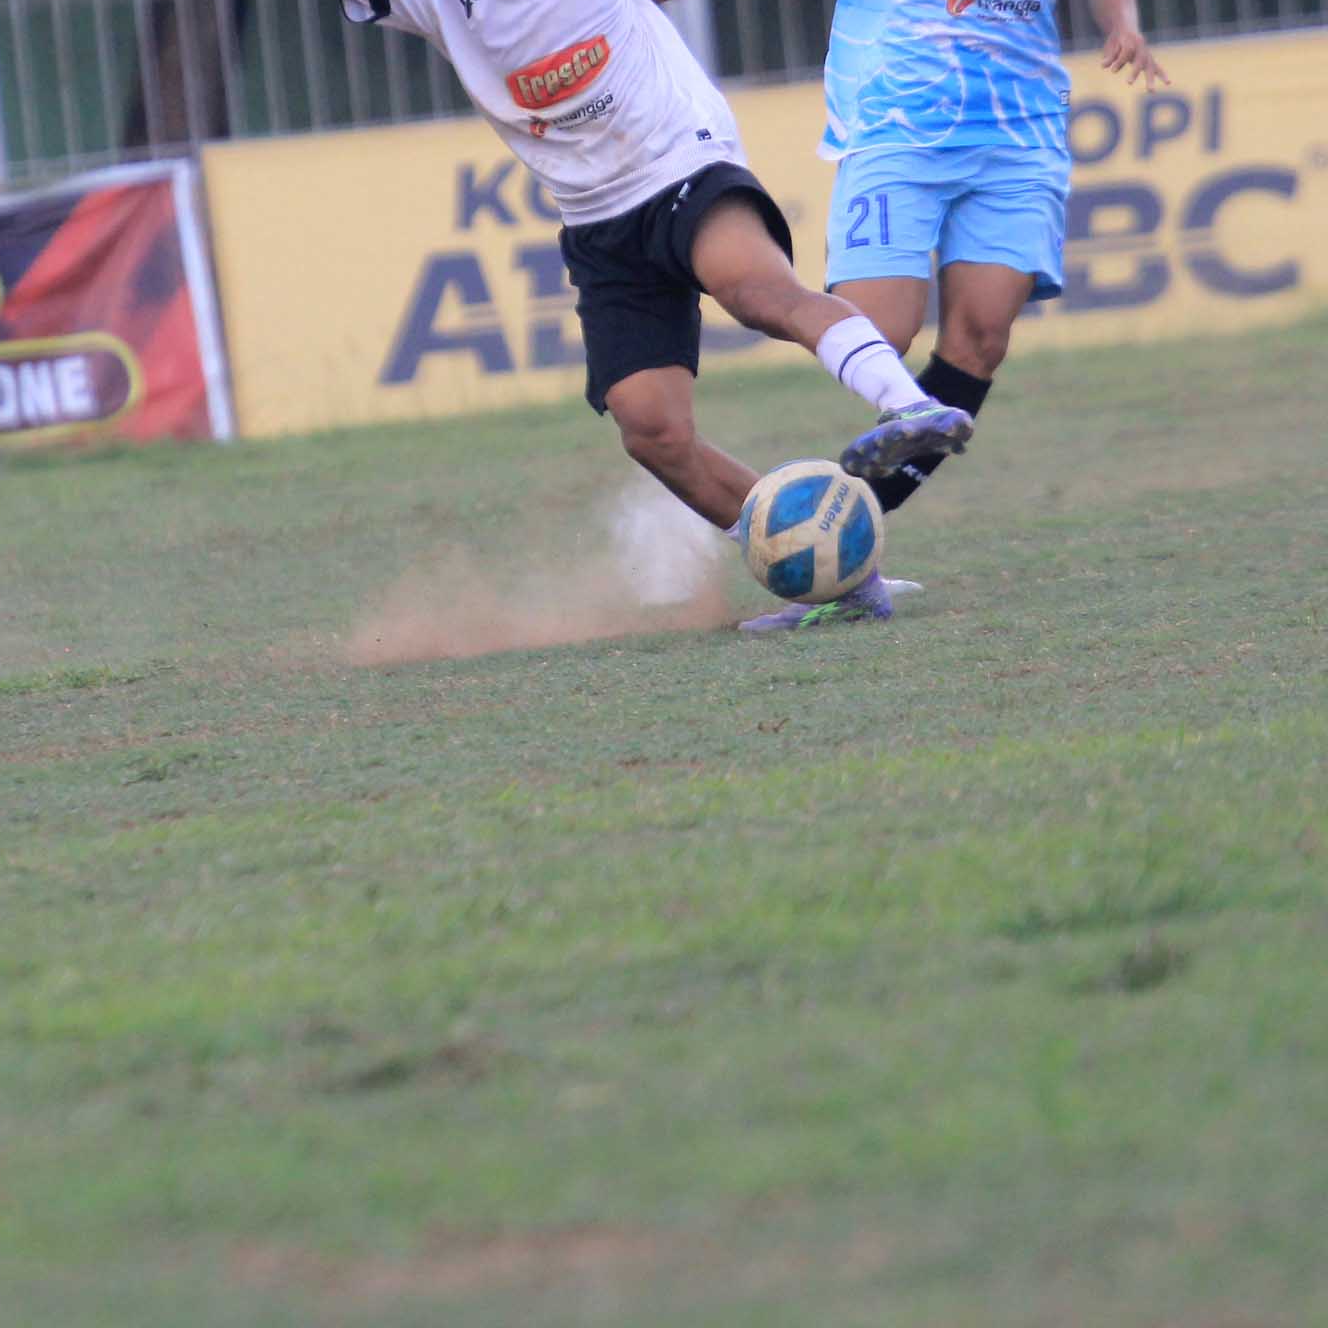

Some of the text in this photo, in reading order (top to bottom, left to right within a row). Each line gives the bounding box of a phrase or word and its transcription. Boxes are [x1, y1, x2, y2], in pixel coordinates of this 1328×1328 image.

[1066, 86, 1226, 170] OPI
[845, 192, 890, 250] 21
[818, 481, 850, 533] molten
